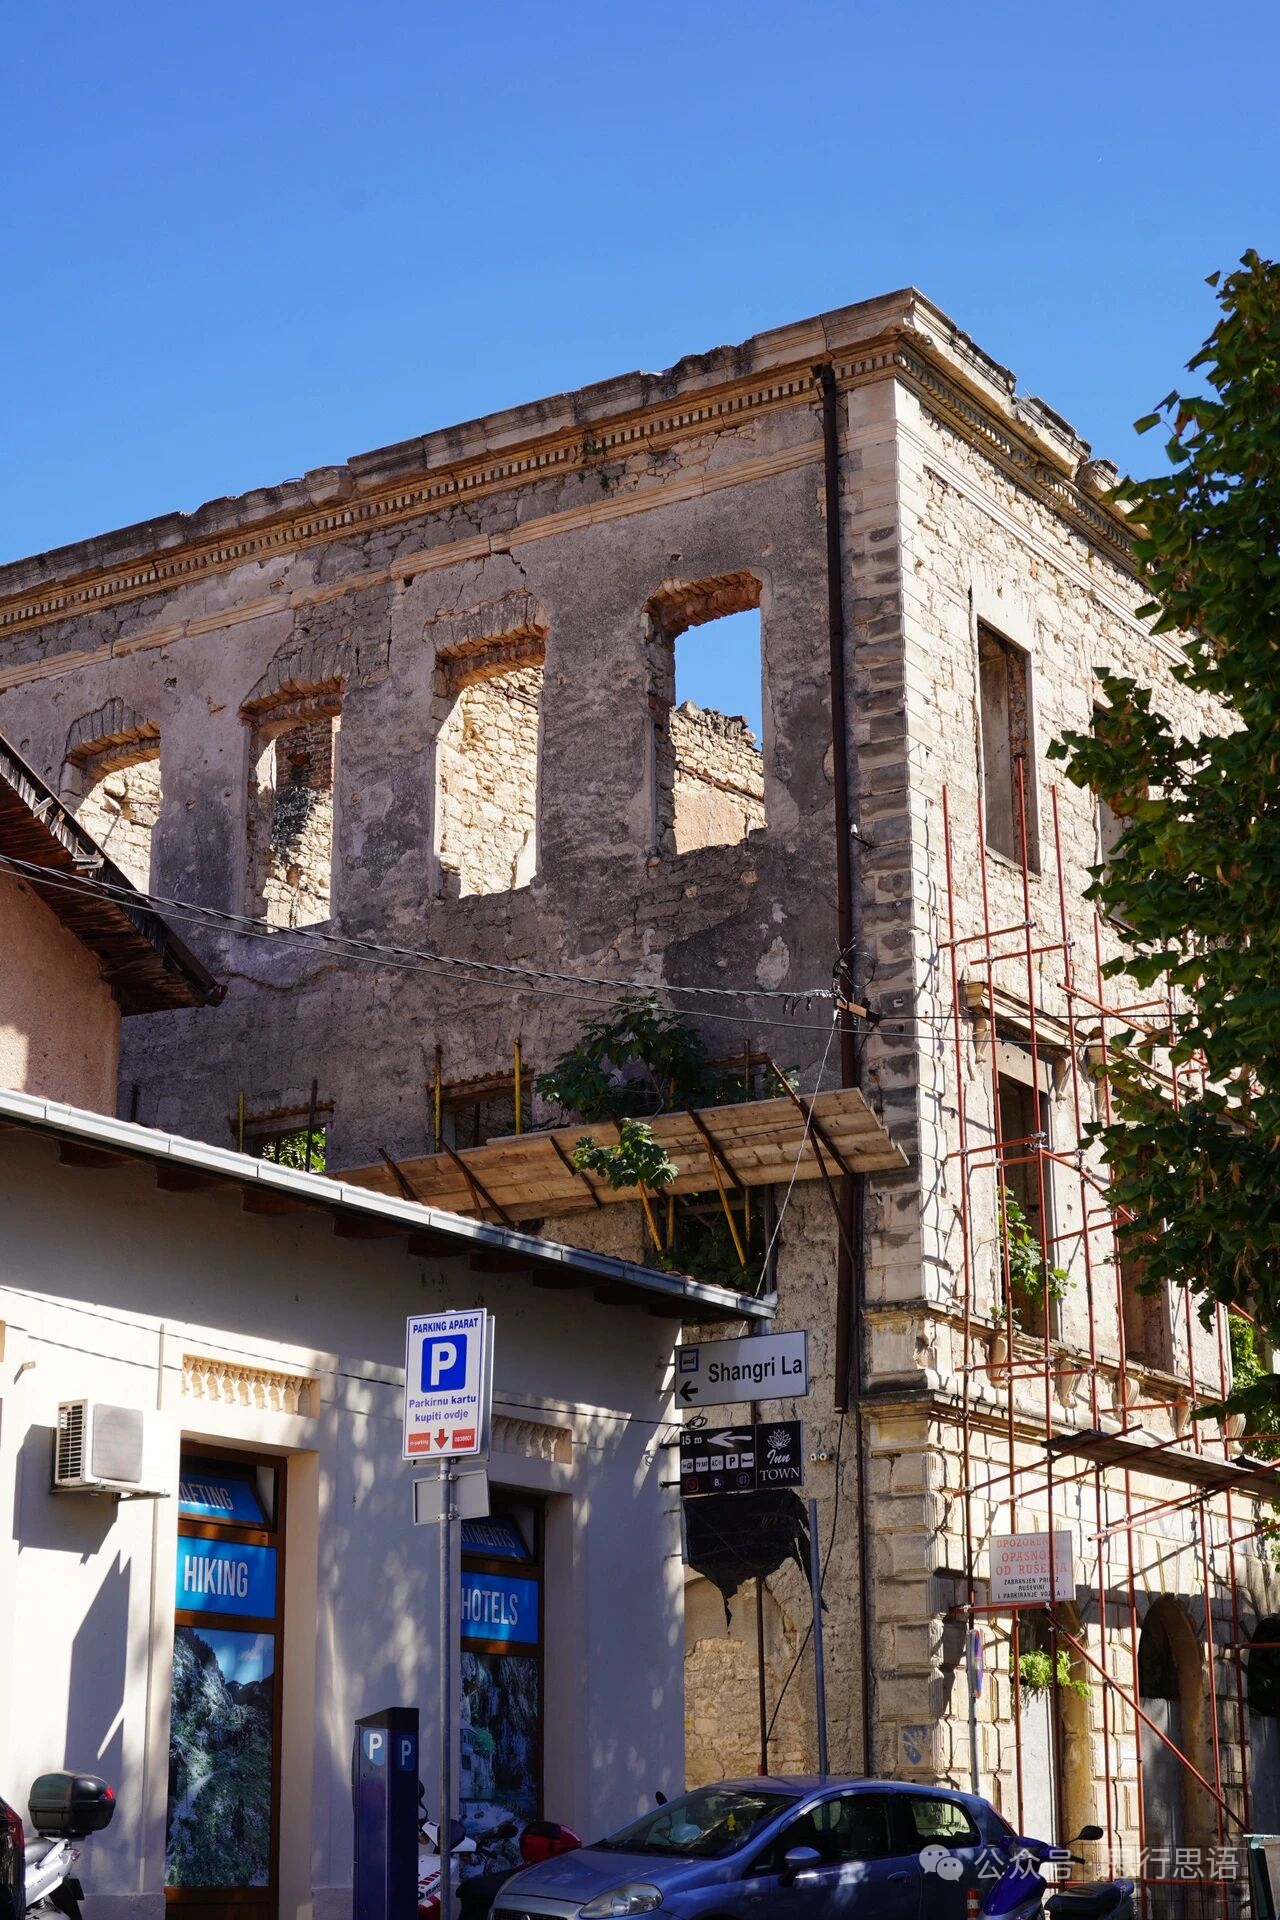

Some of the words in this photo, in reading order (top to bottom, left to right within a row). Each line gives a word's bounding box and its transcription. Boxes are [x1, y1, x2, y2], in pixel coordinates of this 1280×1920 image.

[413, 1321, 447, 1334] PARKING
[449, 1318, 479, 1330] APARAT
[430, 1342, 457, 1386] P
[708, 1357, 775, 1383] Shangri
[781, 1355, 803, 1375] La
[409, 1398, 449, 1408] Parkirnu
[451, 1395, 476, 1404] kartu
[415, 1412, 441, 1424] kupiti
[444, 1409, 469, 1421] ovdje
[681, 1435, 691, 1445] 15
[729, 1456, 736, 1467] P
[767, 1450, 791, 1465] Inn
[760, 1467, 800, 1481] TOWN
[996, 1537, 1060, 1548] UPOZOREN
[1001, 1551, 1063, 1562] OPASNOT
[183, 1555, 248, 1597] HIKING
[996, 1565, 1011, 1576] OD
[1018, 1561, 1068, 1575] RUŠEJA
[461, 1587, 518, 1625] HOTELS
[369, 1733, 383, 1760] P
[401, 1740, 412, 1766] P
